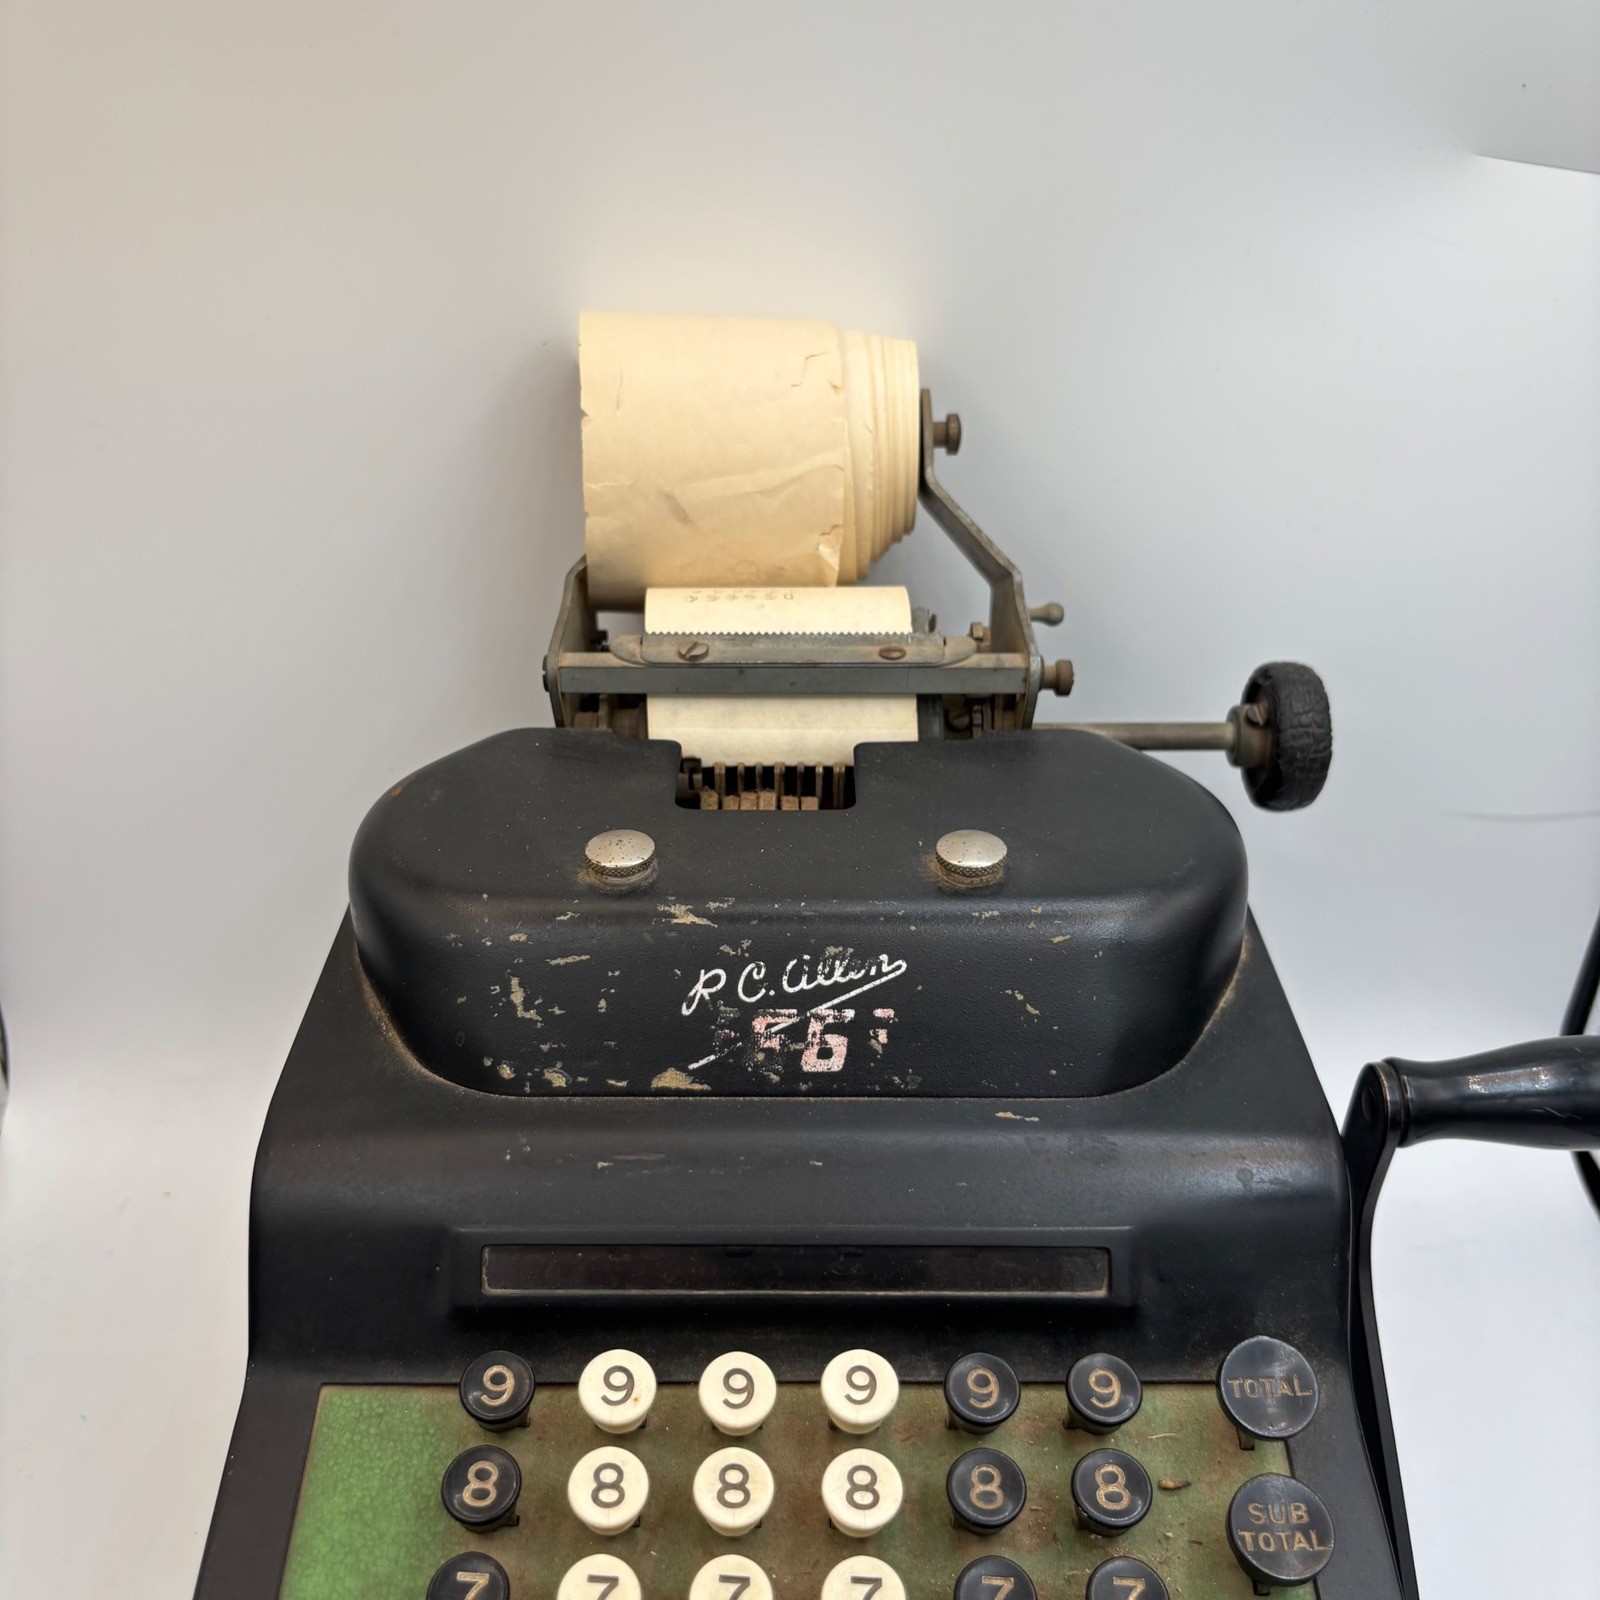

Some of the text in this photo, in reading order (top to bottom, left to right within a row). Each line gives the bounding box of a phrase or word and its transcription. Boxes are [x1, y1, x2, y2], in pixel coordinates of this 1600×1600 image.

[480, 1364, 516, 1406] 9
[600, 1364, 635, 1406] 9
[722, 1367, 756, 1410] 9
[844, 1364, 878, 1406] 9
[966, 1367, 1000, 1409] 9
[1088, 1367, 1122, 1409] 9
[1226, 1375, 1314, 1400] TOTAL
[461, 1460, 498, 1508] 8
[590, 1462, 626, 1509] 8
[716, 1462, 752, 1510] 8
[845, 1464, 880, 1511] 8
[969, 1463, 1004, 1510] 8
[1094, 1463, 1131, 1511] 8
[1247, 1503, 1310, 1526] SUB
[1238, 1530, 1334, 1552] TOTAL
[456, 1570, 490, 1600] 7
[586, 1573, 620, 1600] 7
[718, 1573, 751, 1600] 7
[850, 1575, 883, 1600] 7
[981, 1575, 1015, 1600] 7
[1112, 1576, 1146, 1600] 7
